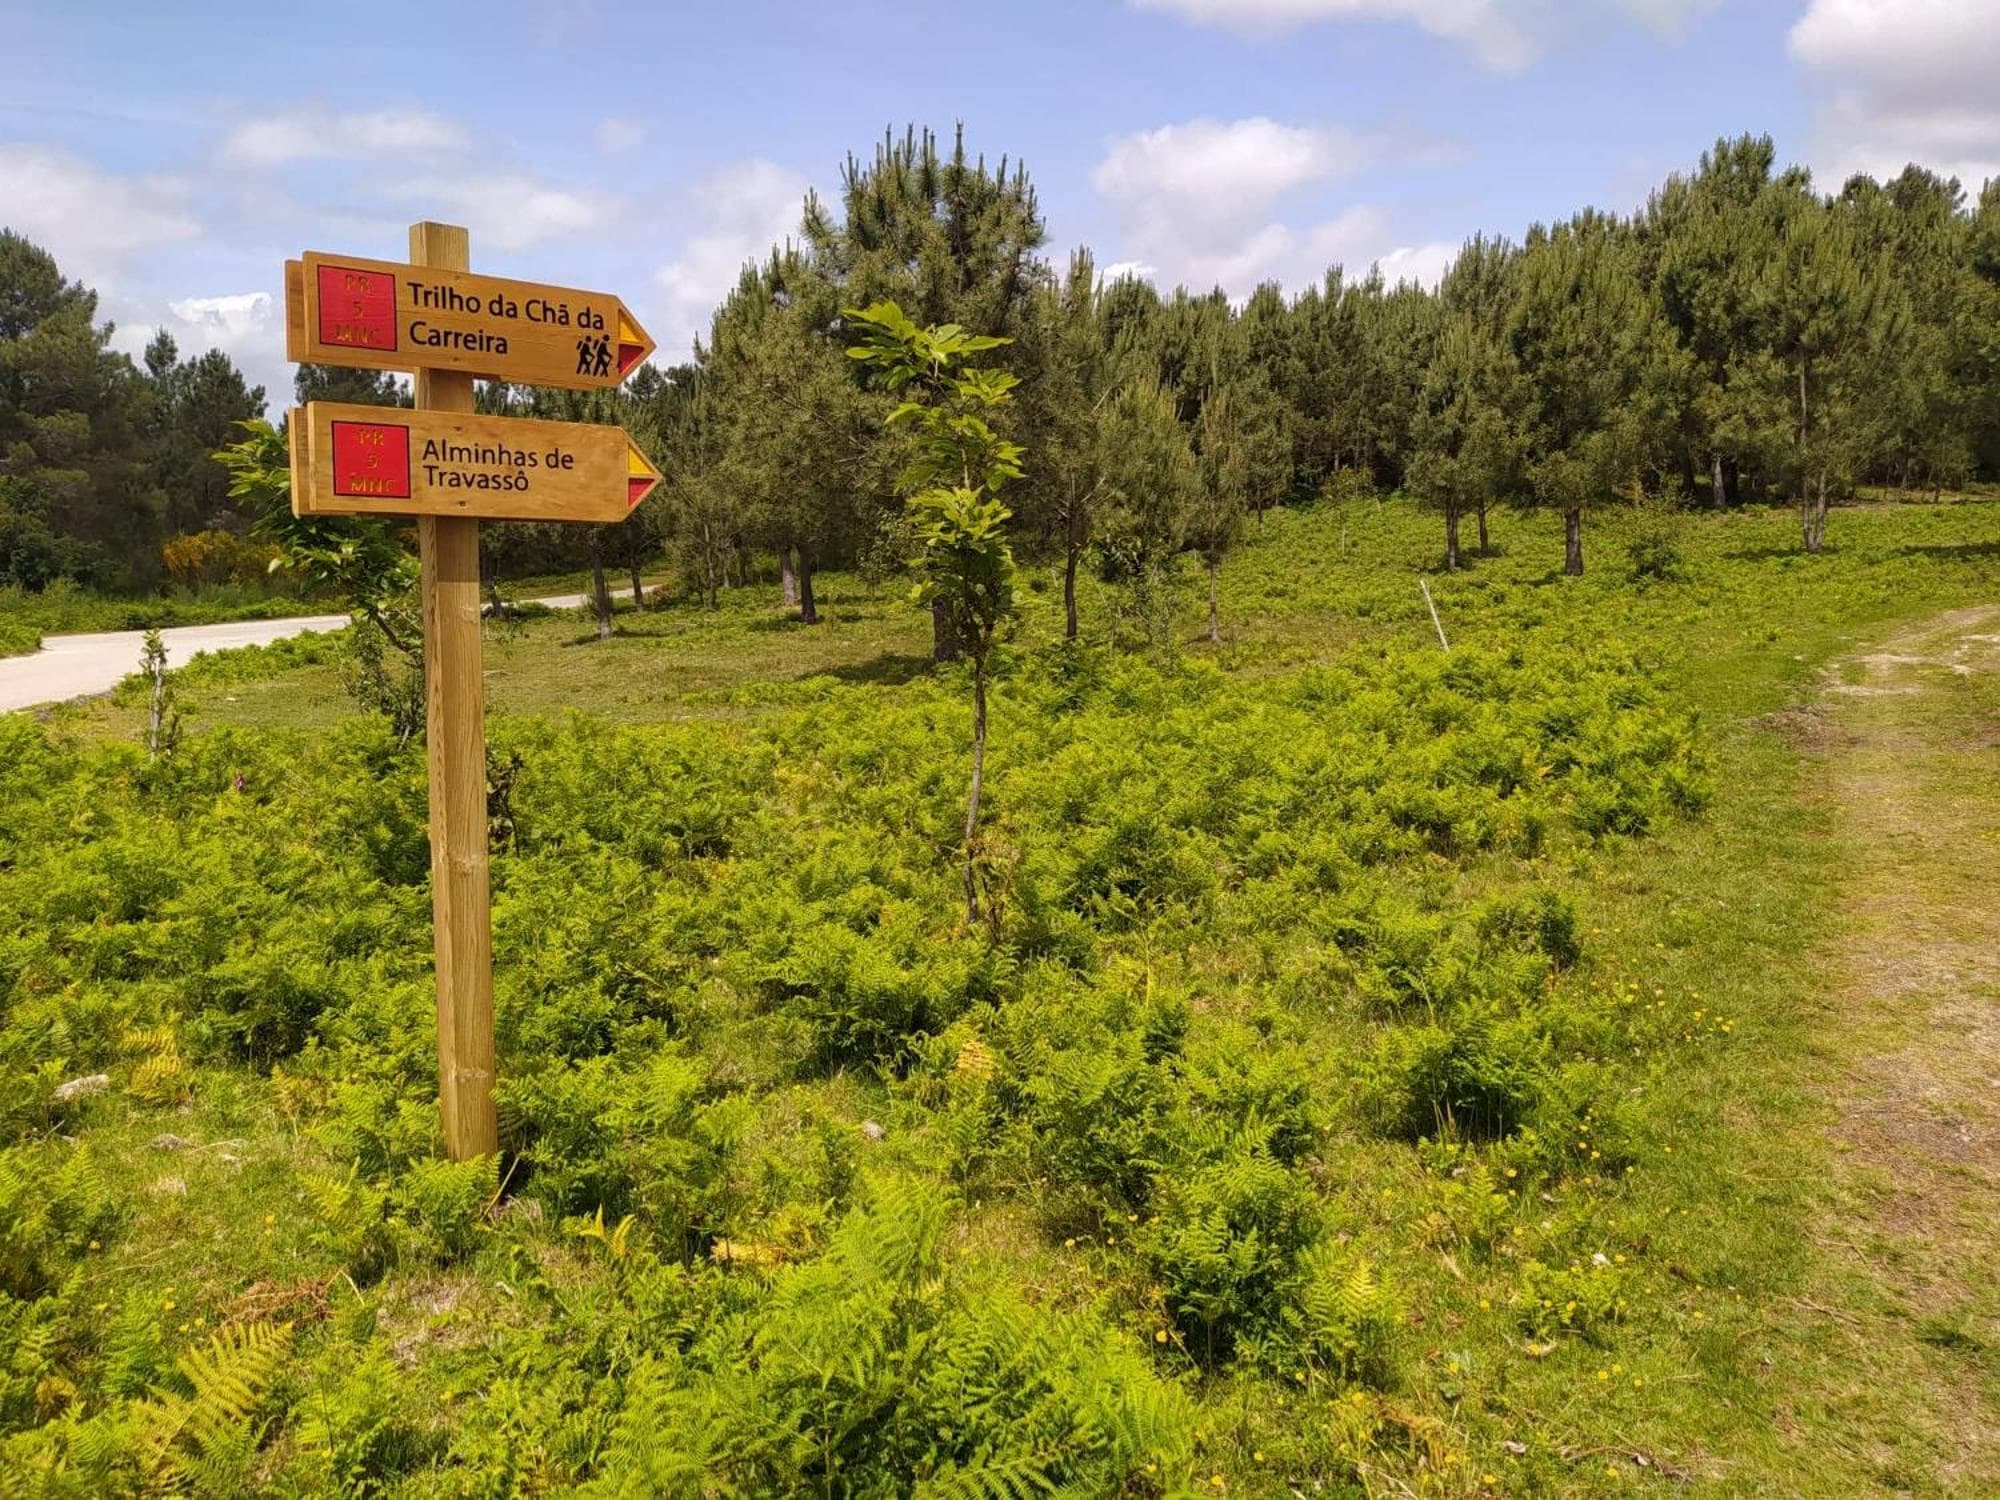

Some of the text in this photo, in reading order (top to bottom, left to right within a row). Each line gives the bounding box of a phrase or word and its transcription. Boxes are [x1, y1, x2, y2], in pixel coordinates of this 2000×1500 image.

[407, 281, 604, 330] Trilho da Chã da
[409, 321, 509, 354] Carreira
[422, 439, 574, 470] Alminhas de
[423, 465, 530, 492] Travassô
